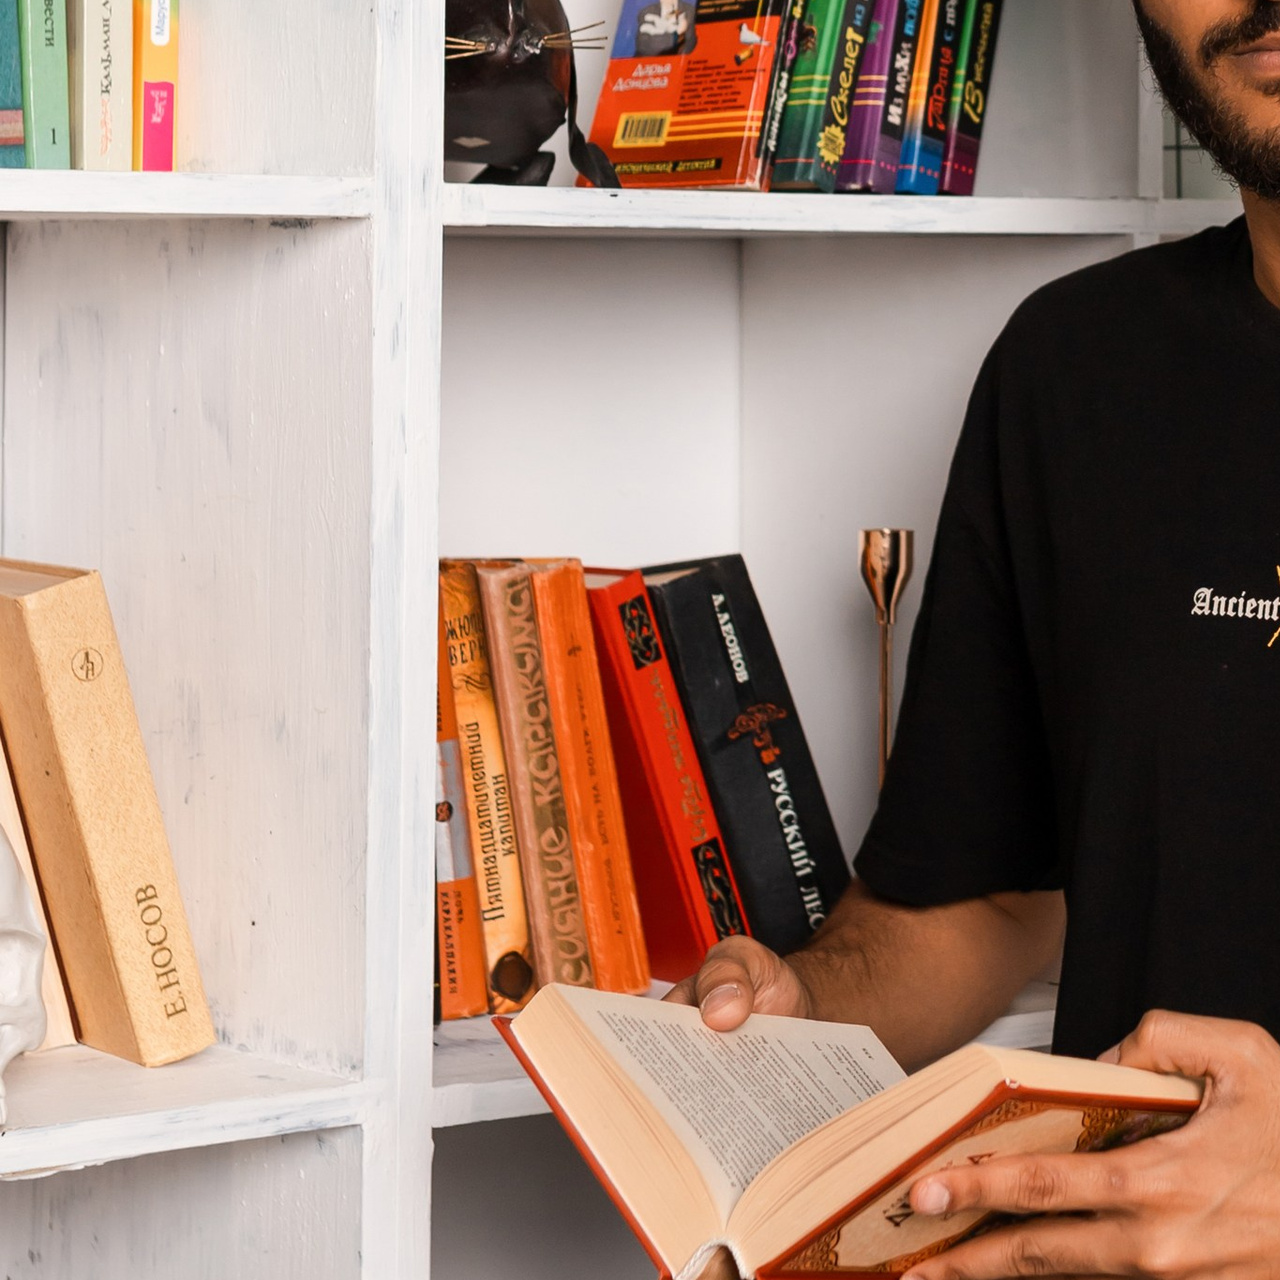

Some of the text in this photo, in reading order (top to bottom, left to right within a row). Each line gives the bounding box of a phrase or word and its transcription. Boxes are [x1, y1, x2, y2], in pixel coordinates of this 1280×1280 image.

[963, 82, 985, 123] 13
[464, 722, 506, 923] Пятнадцатилетний
[491, 773, 517, 858] капитан
[766, 766, 815, 879] РУССКИЙ
